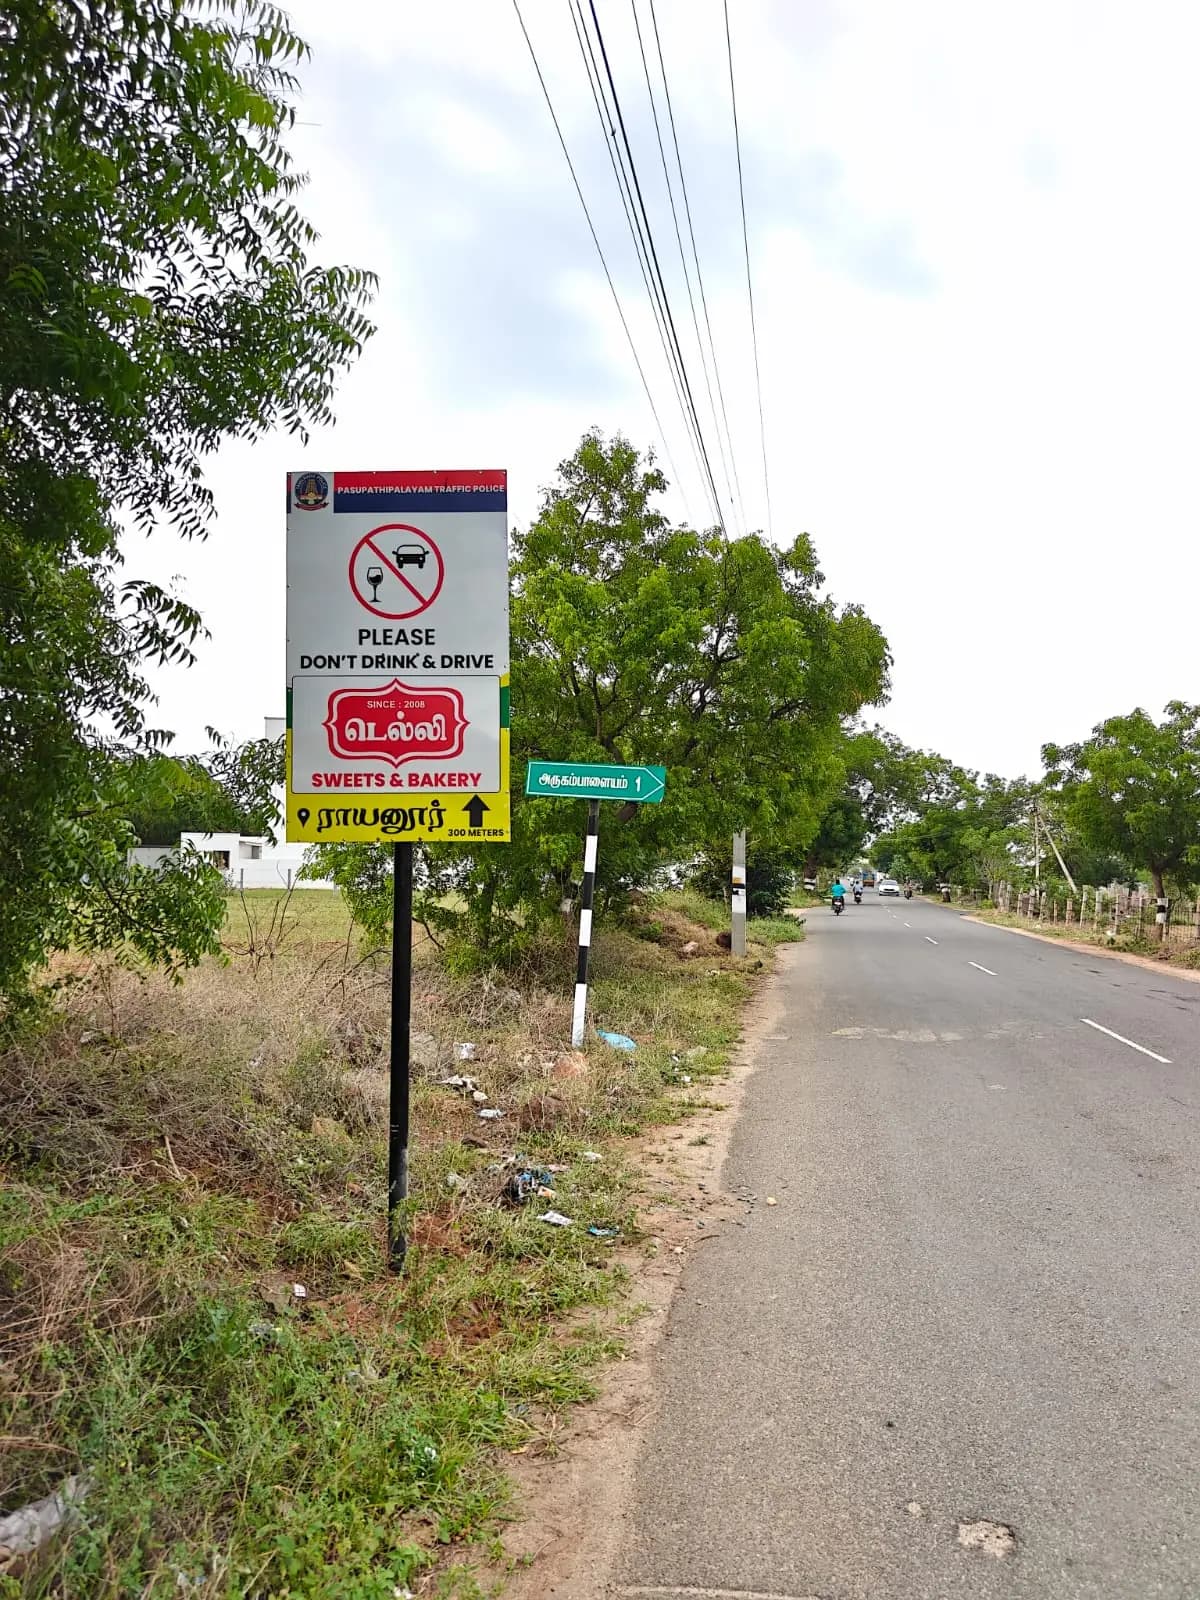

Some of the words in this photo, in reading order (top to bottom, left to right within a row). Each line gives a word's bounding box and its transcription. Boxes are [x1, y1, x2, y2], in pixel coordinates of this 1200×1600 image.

[337, 485, 433, 494] PASUPATHIPALAYAM
[434, 485, 471, 493] TRAFFIC
[473, 484, 505, 493] POLICE
[358, 629, 436, 645] PLEASE
[300, 655, 357, 669] DON'T
[362, 655, 417, 669] DRINK
[422, 655, 436, 668] &
[441, 655, 494, 668] DRIVE
[367, 700, 395, 709] SINCE
[404, 700, 425, 708] 2008
[345, 711, 447, 741] டெல்லி
[312, 773, 385, 787] SWEETS
[389, 773, 404, 787] &
[408, 773, 482, 787] BAKERY
[635, 776, 641, 792] 1
[317, 799, 447, 834] ராயனூர்
[447, 829, 465, 837] 300
[468, 829, 504, 837] METERS
